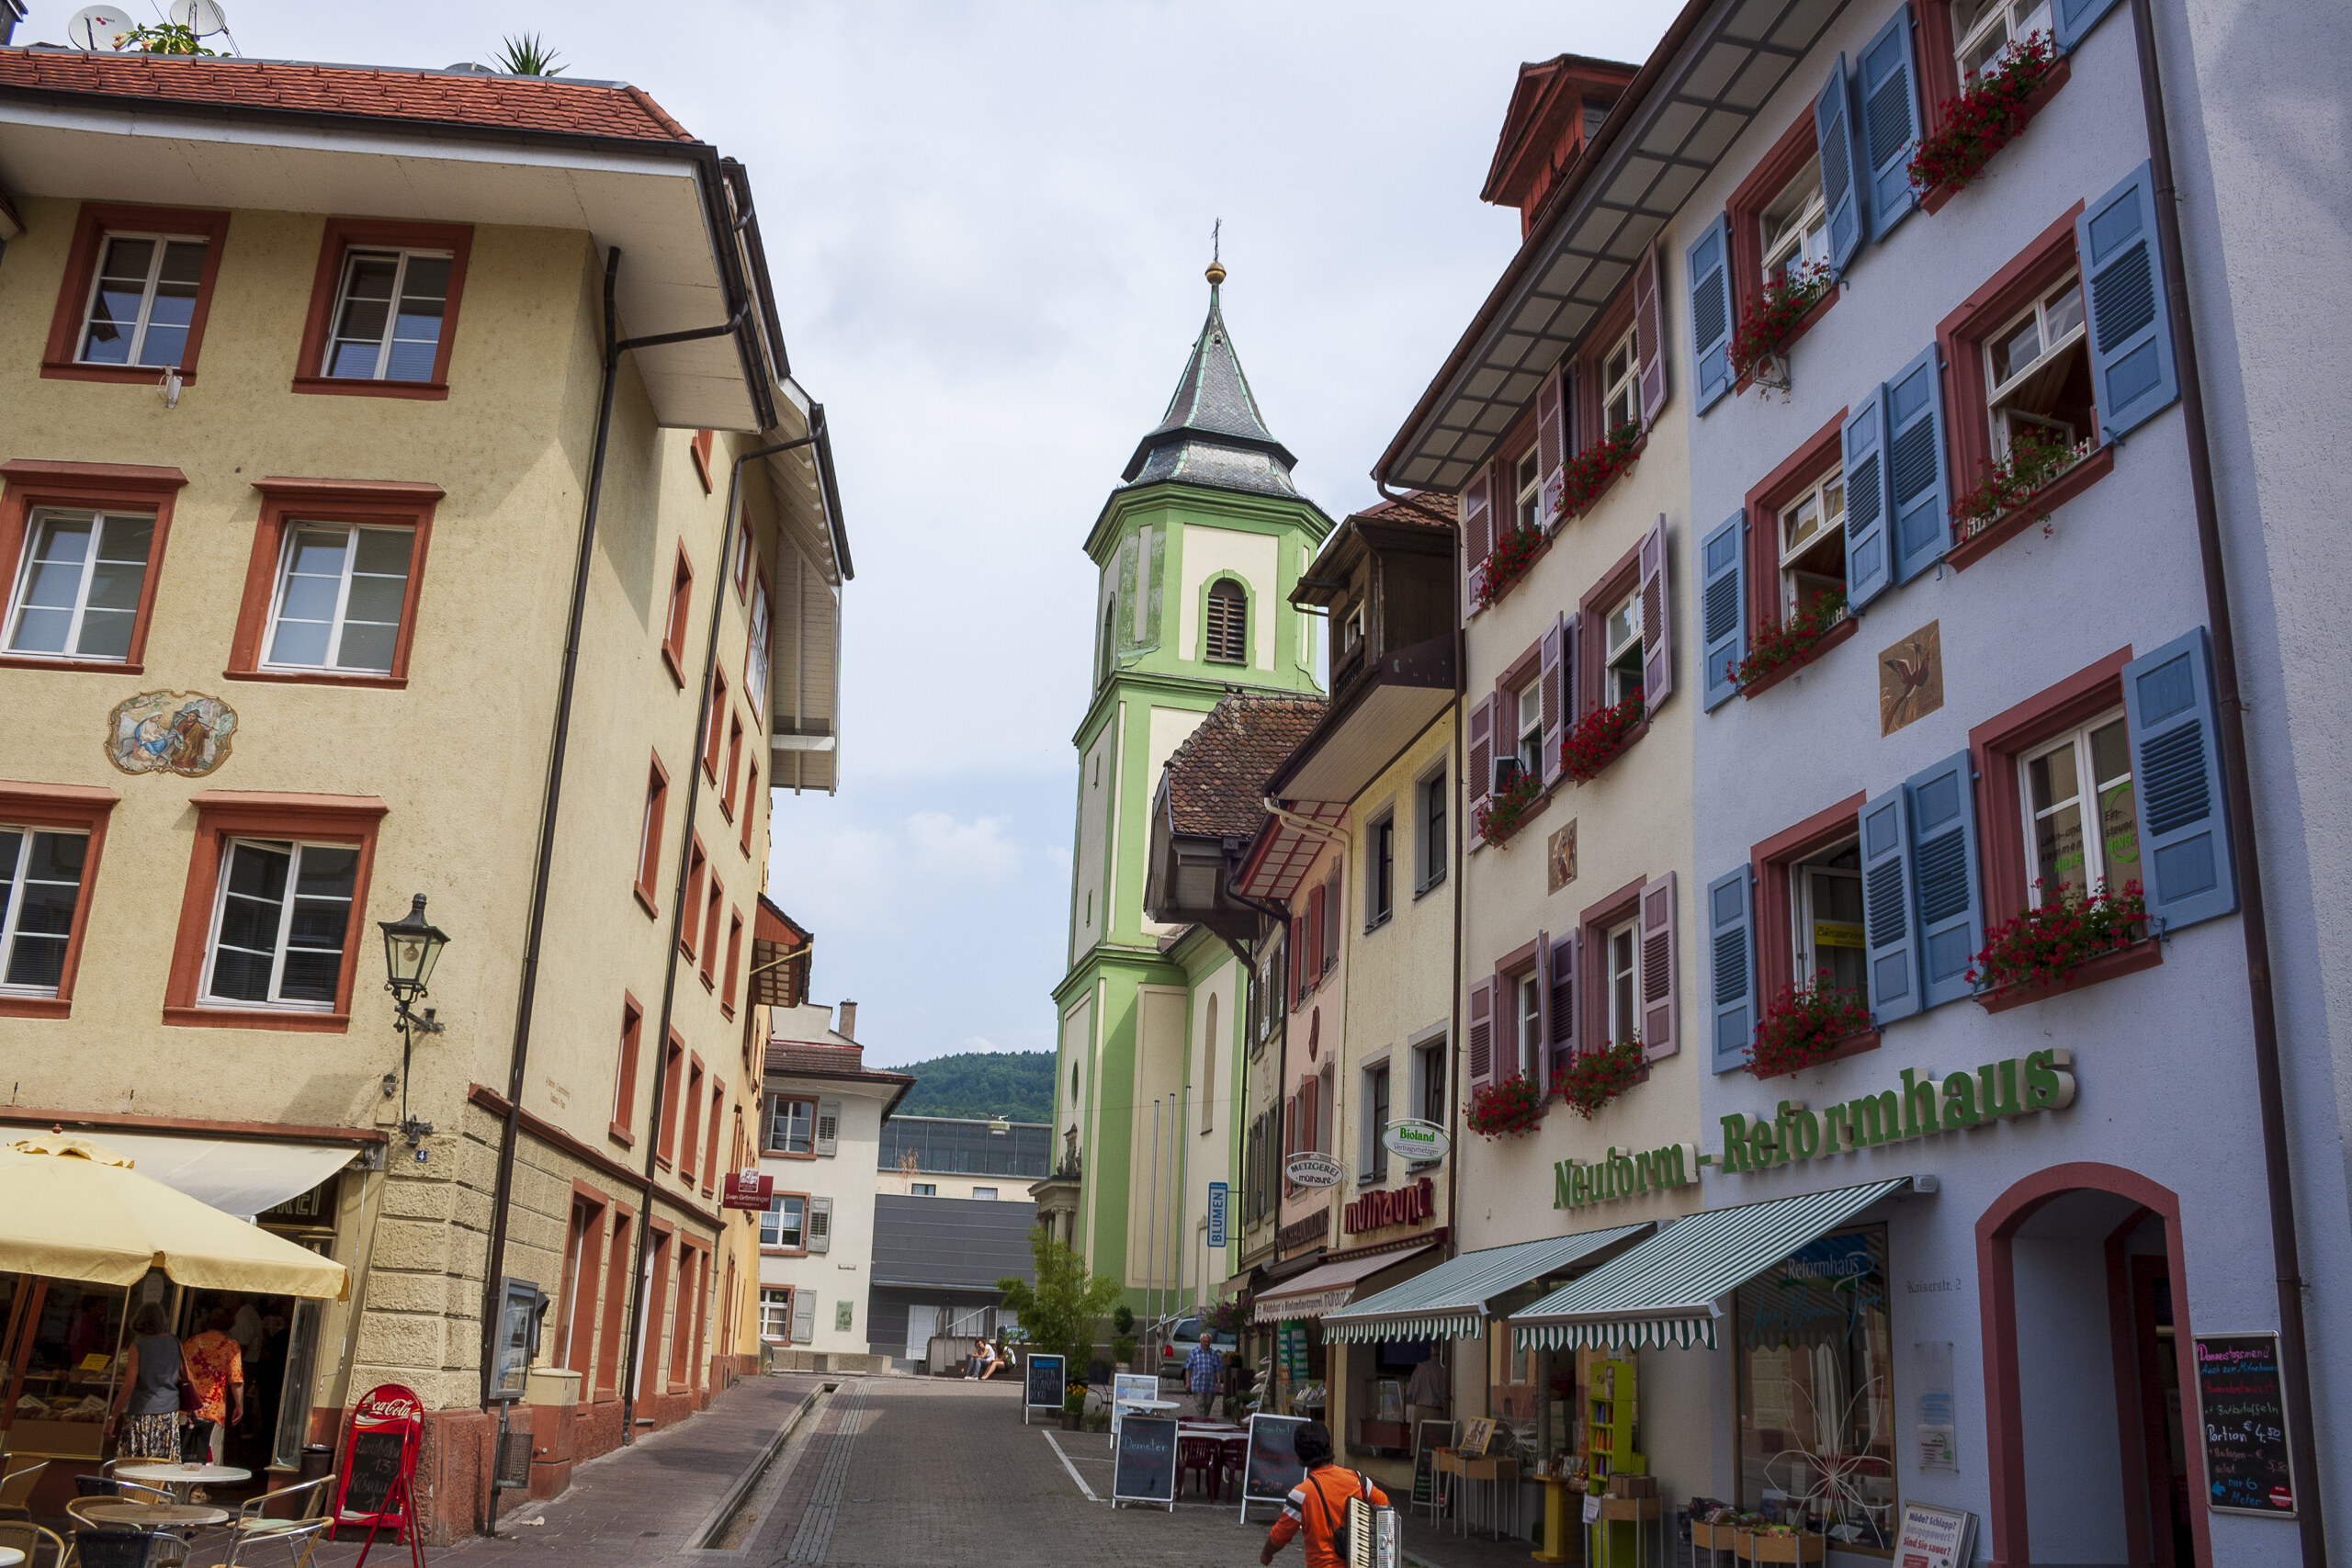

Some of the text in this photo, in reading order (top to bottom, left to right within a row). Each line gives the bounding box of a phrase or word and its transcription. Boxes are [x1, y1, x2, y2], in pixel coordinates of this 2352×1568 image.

[1399, 1127, 1435, 1142] Bioland
[418, 1150, 424, 1160] 4
[1393, 1143, 1439, 1156] Vertragsmetzger
[1291, 1162, 1339, 1177] METZGEREI
[1212, 1192, 1224, 1242] BLUMEN
[1787, 1253, 1860, 1280] Reformhaus
[1956, 1278, 1962, 1290] 2
[2205, 1424, 2247, 1442] Portion
[2244, 1420, 2252, 1431] €
[1121, 1435, 1168, 1452] Demeter
[2228, 1476, 2257, 1490] nur 6
[2230, 1491, 2262, 1506] Meter
[1908, 1512, 1957, 1531] Müde? Schlapp?
[1905, 1524, 1955, 1542] Ausgepowert?
[1917, 1540, 1928, 1551] Sie
[1928, 1544, 1951, 1556] sauer?
